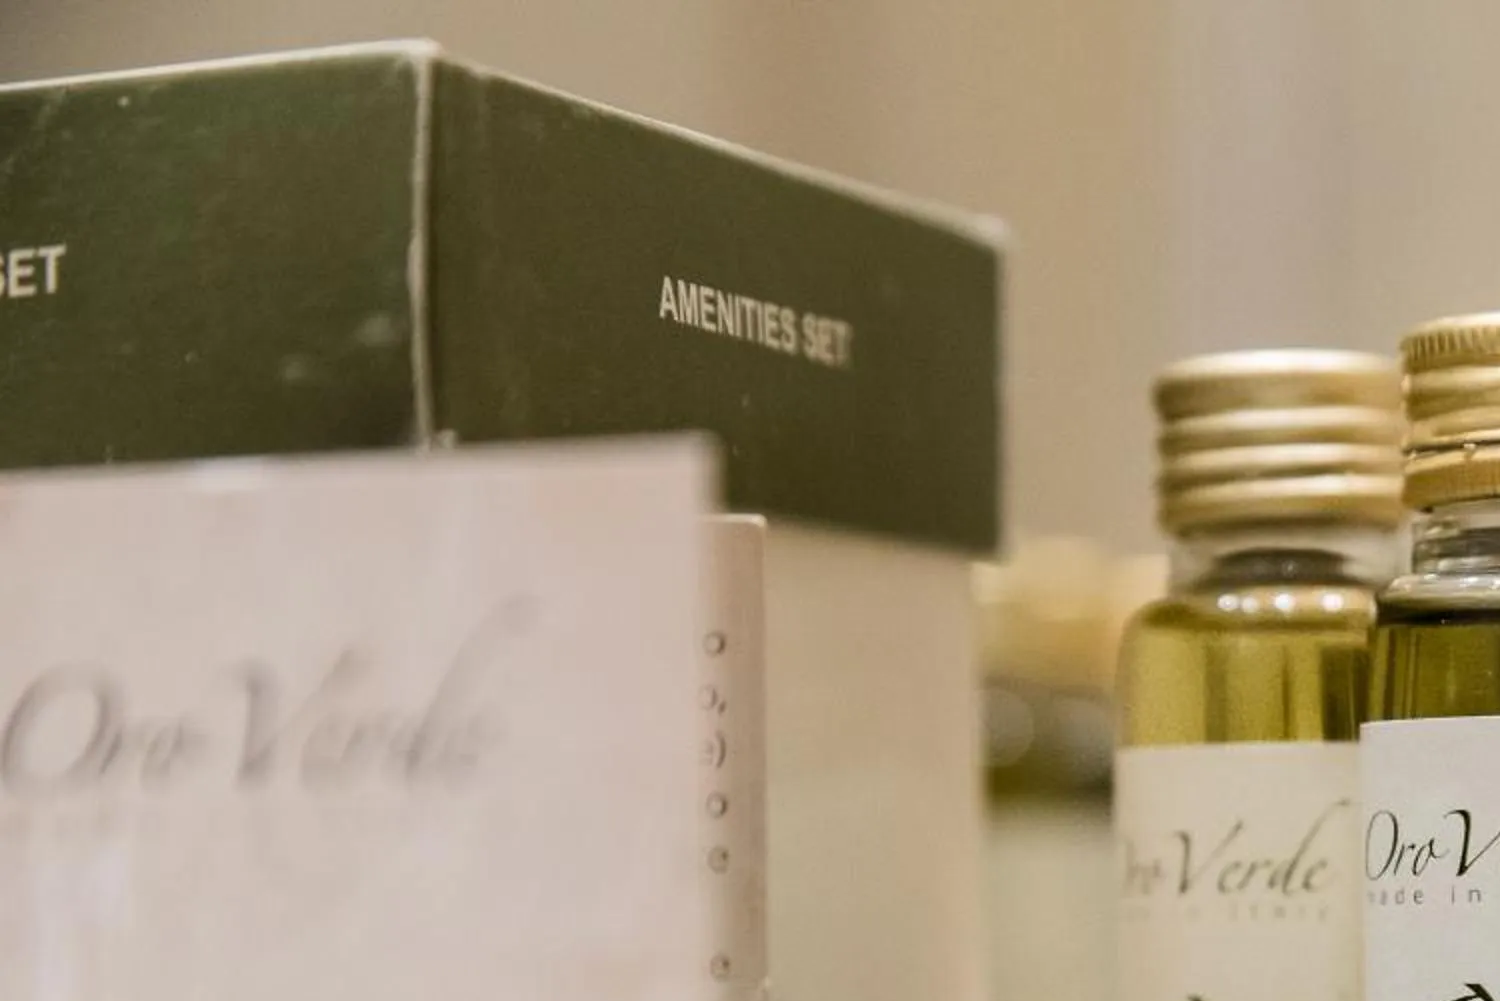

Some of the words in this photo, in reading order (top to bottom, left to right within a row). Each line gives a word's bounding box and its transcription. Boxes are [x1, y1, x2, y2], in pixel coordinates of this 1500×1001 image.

[0, 243, 67, 298] ET
[658, 274, 797, 356] AMENITIES
[801, 311, 854, 368] SET
[1450, 885, 1482, 903] in
